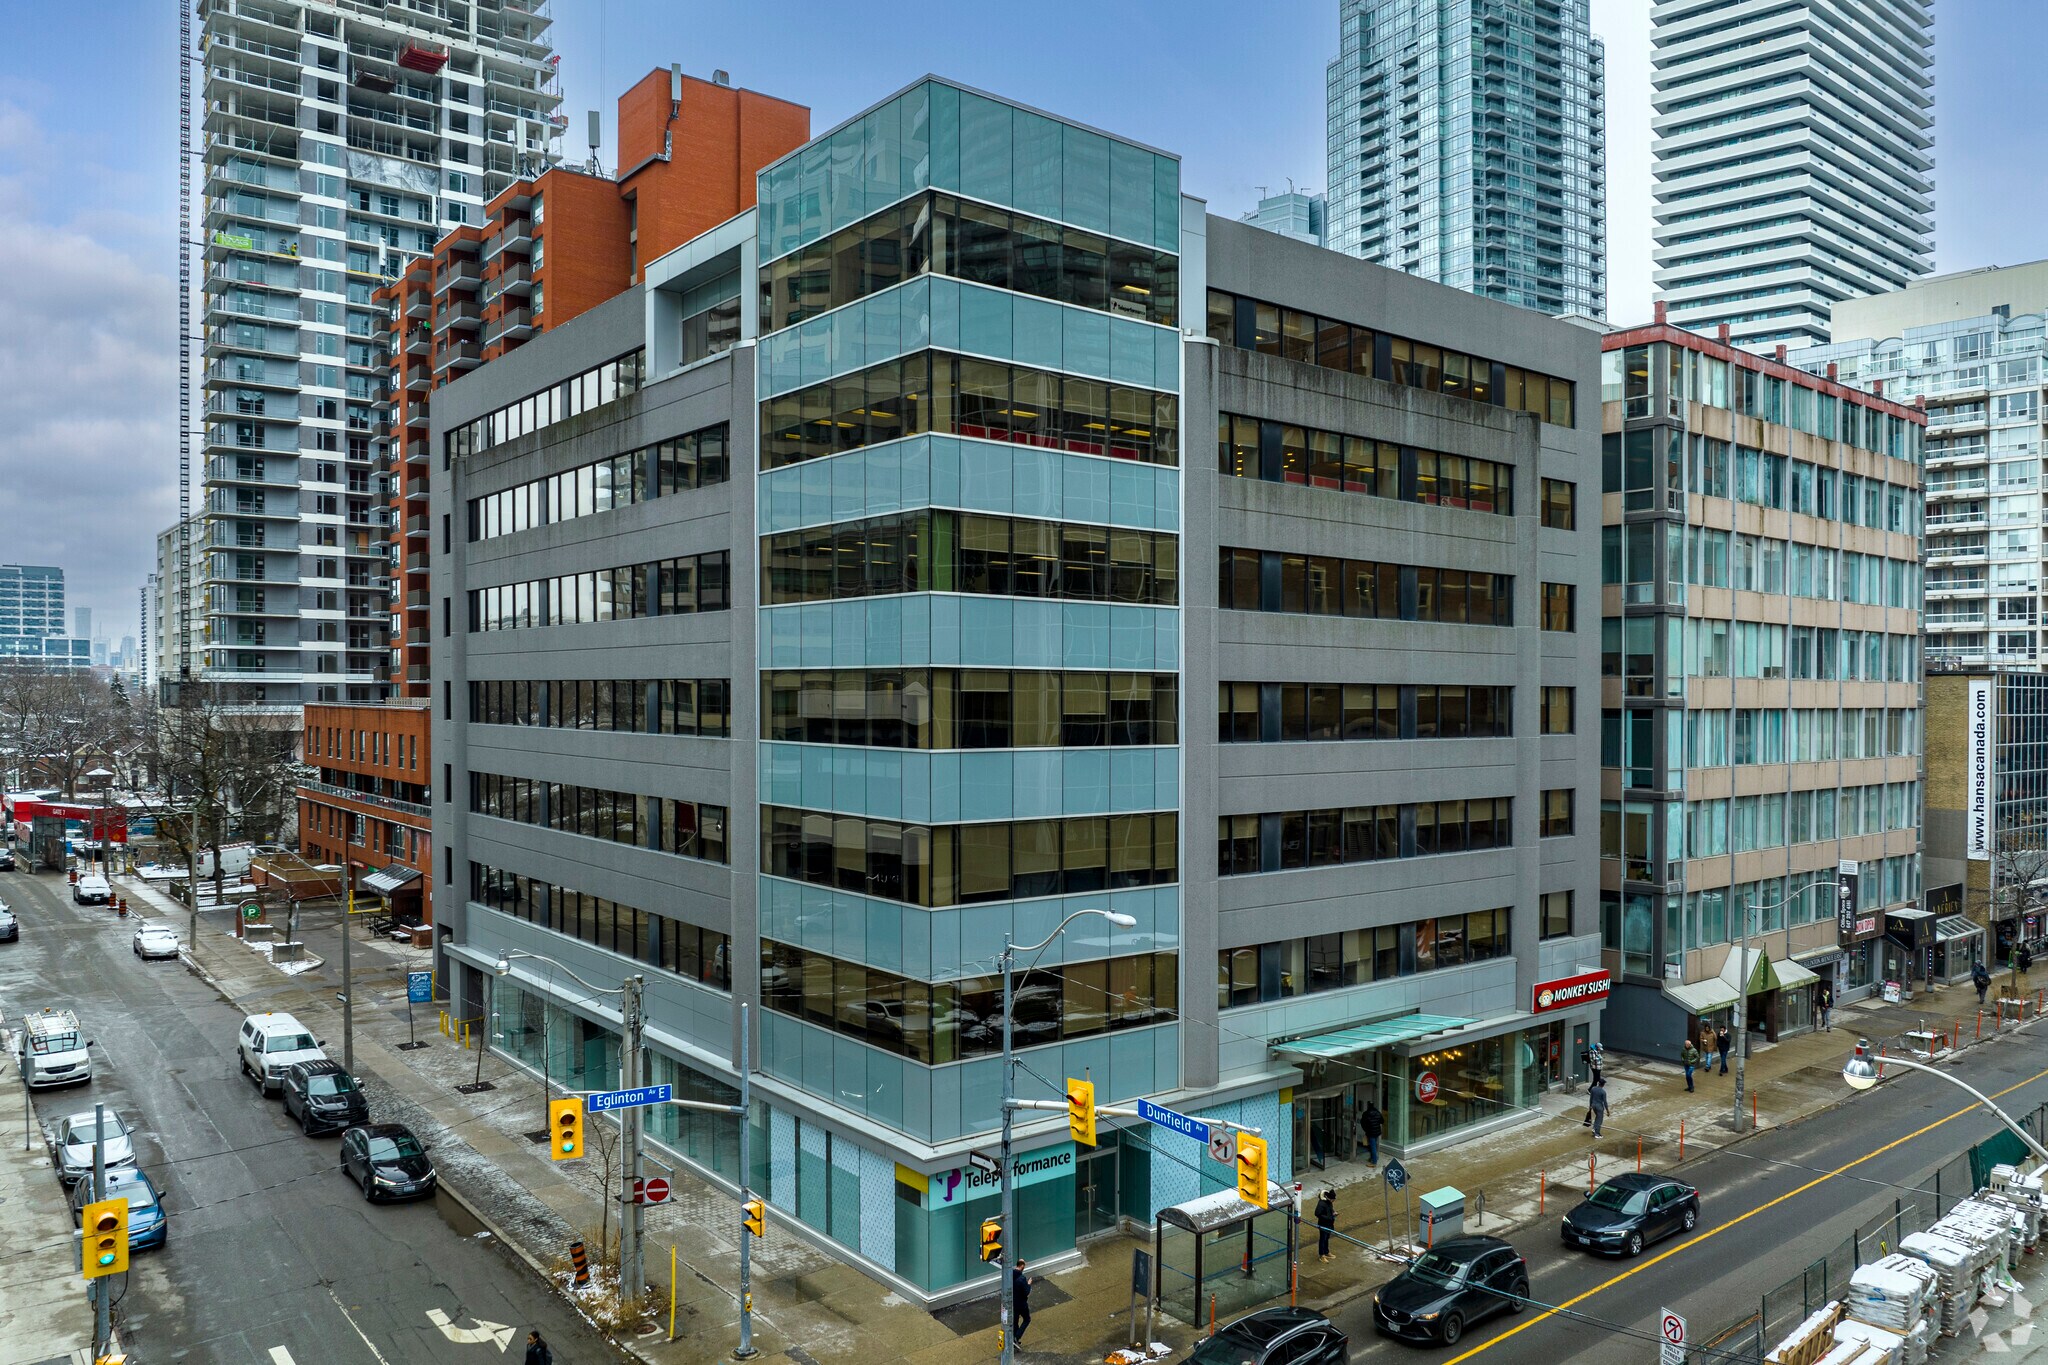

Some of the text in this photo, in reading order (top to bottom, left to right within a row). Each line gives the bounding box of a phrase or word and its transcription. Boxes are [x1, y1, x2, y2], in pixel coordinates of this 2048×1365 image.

[1973, 690, 1986, 851] www.hansacanada.com
[1554, 978, 1611, 1002] MONKEY SUSHI
[597, 1087, 665, 1109] Eglinton Av E
[1147, 1103, 1203, 1133] Dunfield Av
[965, 1152, 1071, 1189] Telepformance
